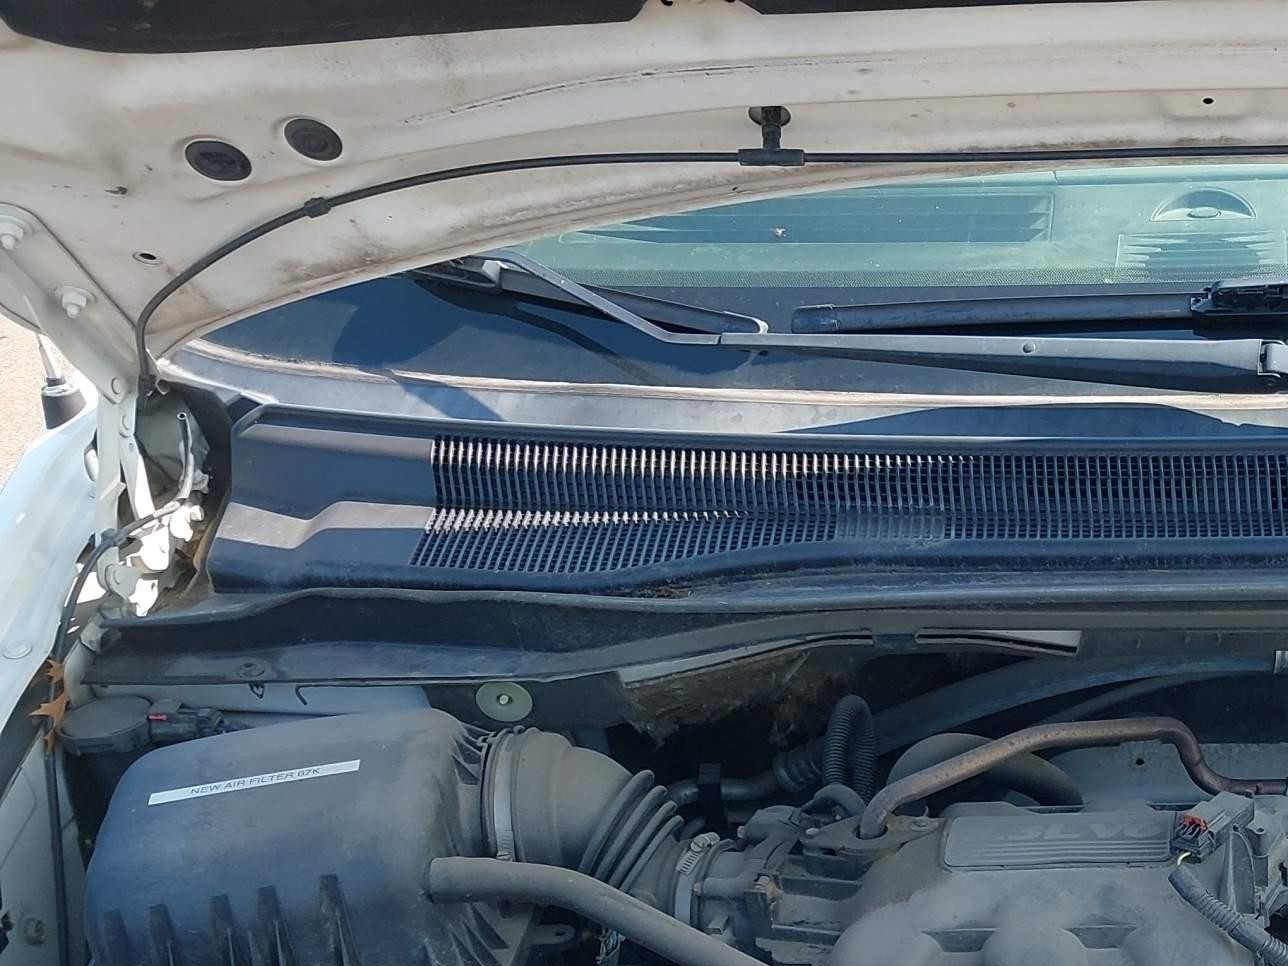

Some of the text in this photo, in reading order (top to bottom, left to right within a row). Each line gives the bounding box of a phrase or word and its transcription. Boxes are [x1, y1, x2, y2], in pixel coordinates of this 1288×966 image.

[190, 783, 221, 795] NEW
[224, 779, 246, 790] AIR
[249, 772, 294, 785] FILTER
